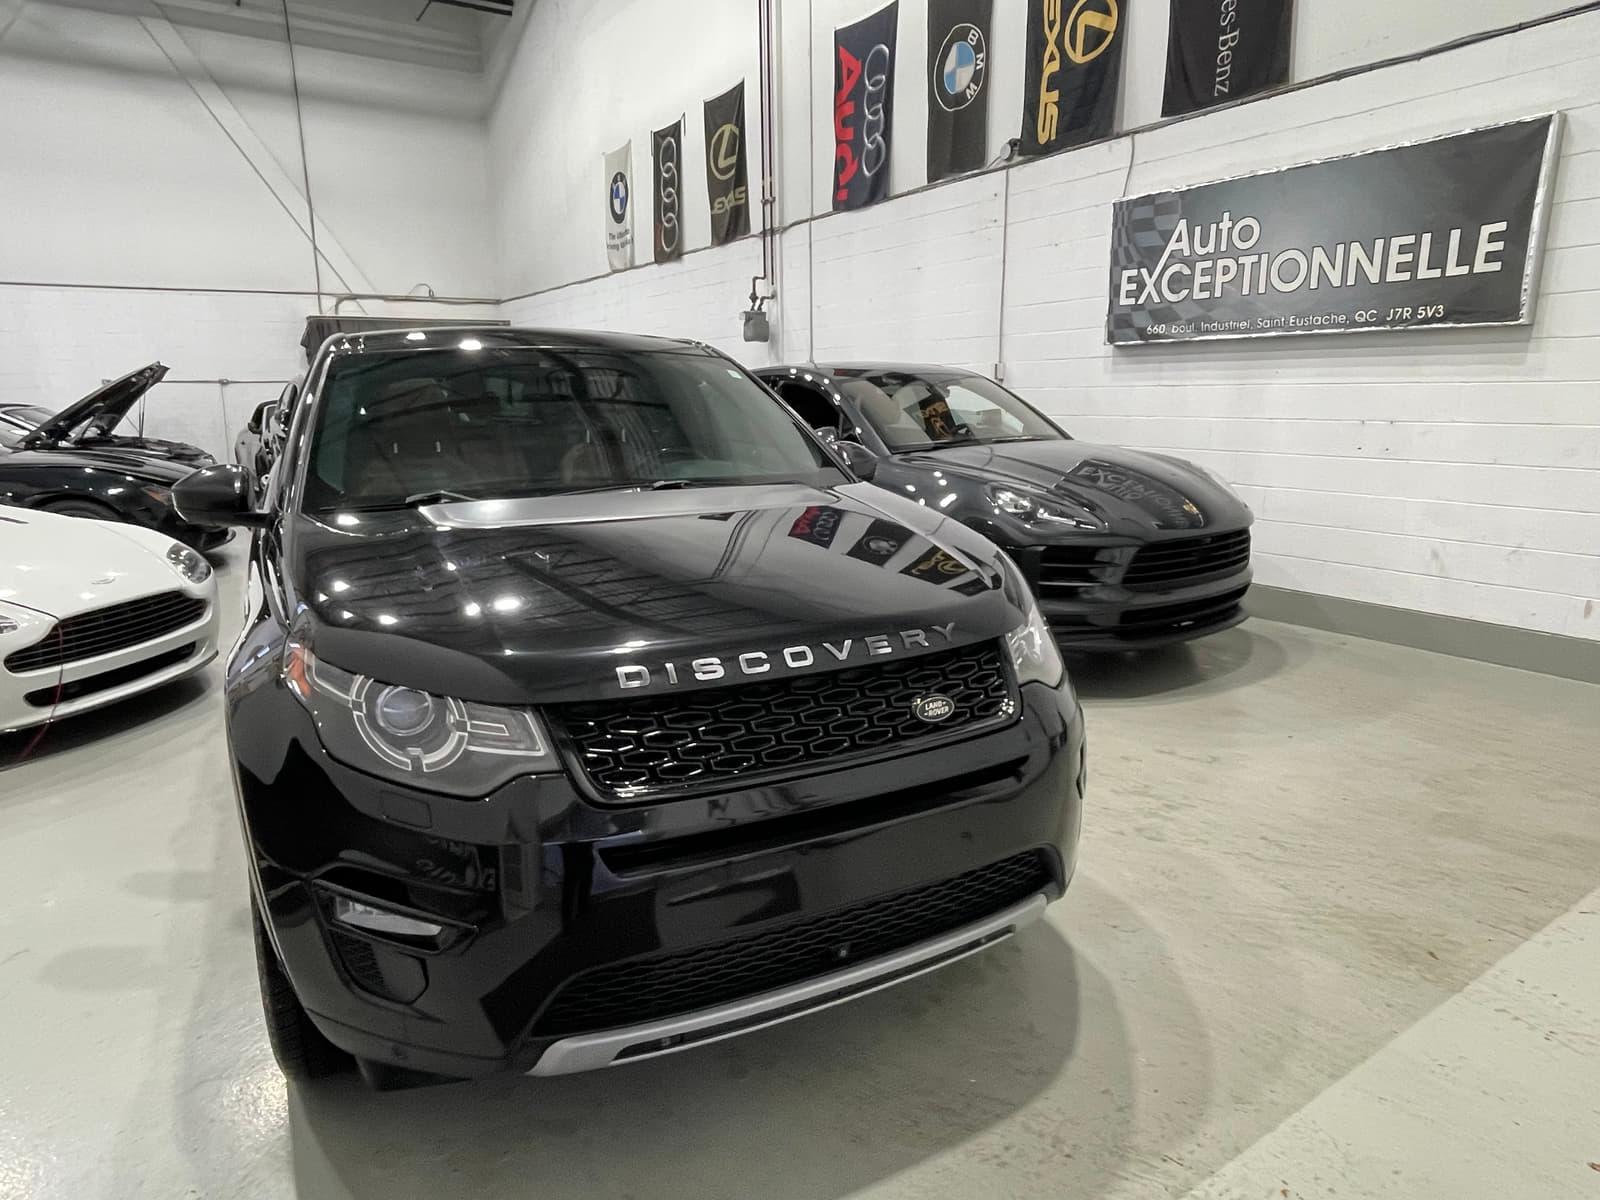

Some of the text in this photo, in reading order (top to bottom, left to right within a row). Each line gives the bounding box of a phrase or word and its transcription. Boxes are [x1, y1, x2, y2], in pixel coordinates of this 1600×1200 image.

[965, 29, 984, 100] BMW
[1119, 221, 1508, 306] EXCEPTIONNELLE
[1162, 210, 1261, 258] Auto
[1355, 309, 1377, 323] QC
[1386, 306, 1412, 321] J7R
[1417, 304, 1444, 319] 5V3
[615, 622, 956, 689] DISCOVERY
